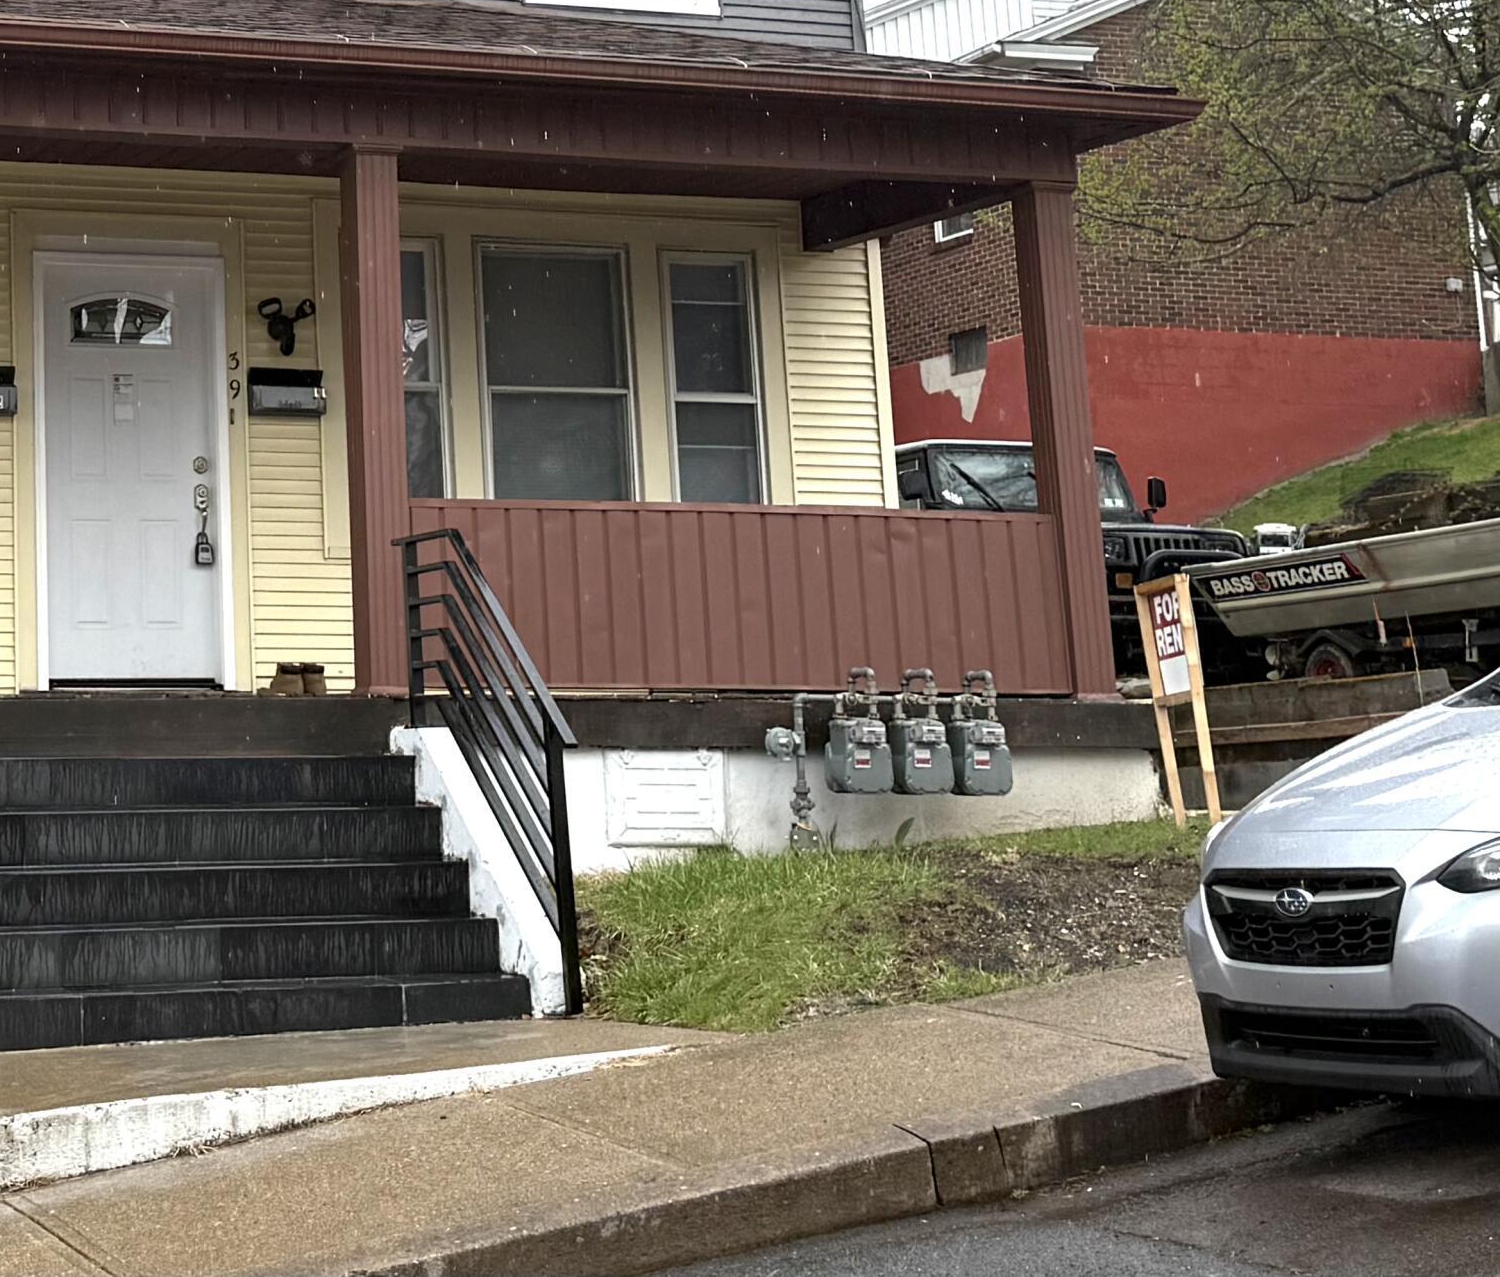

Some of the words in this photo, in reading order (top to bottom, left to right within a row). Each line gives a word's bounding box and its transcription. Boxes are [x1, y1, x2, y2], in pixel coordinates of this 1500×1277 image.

[1210, 575, 1255, 596] BASS
[1266, 561, 1349, 589] TRACKER
[1155, 623, 1184, 657] REN
